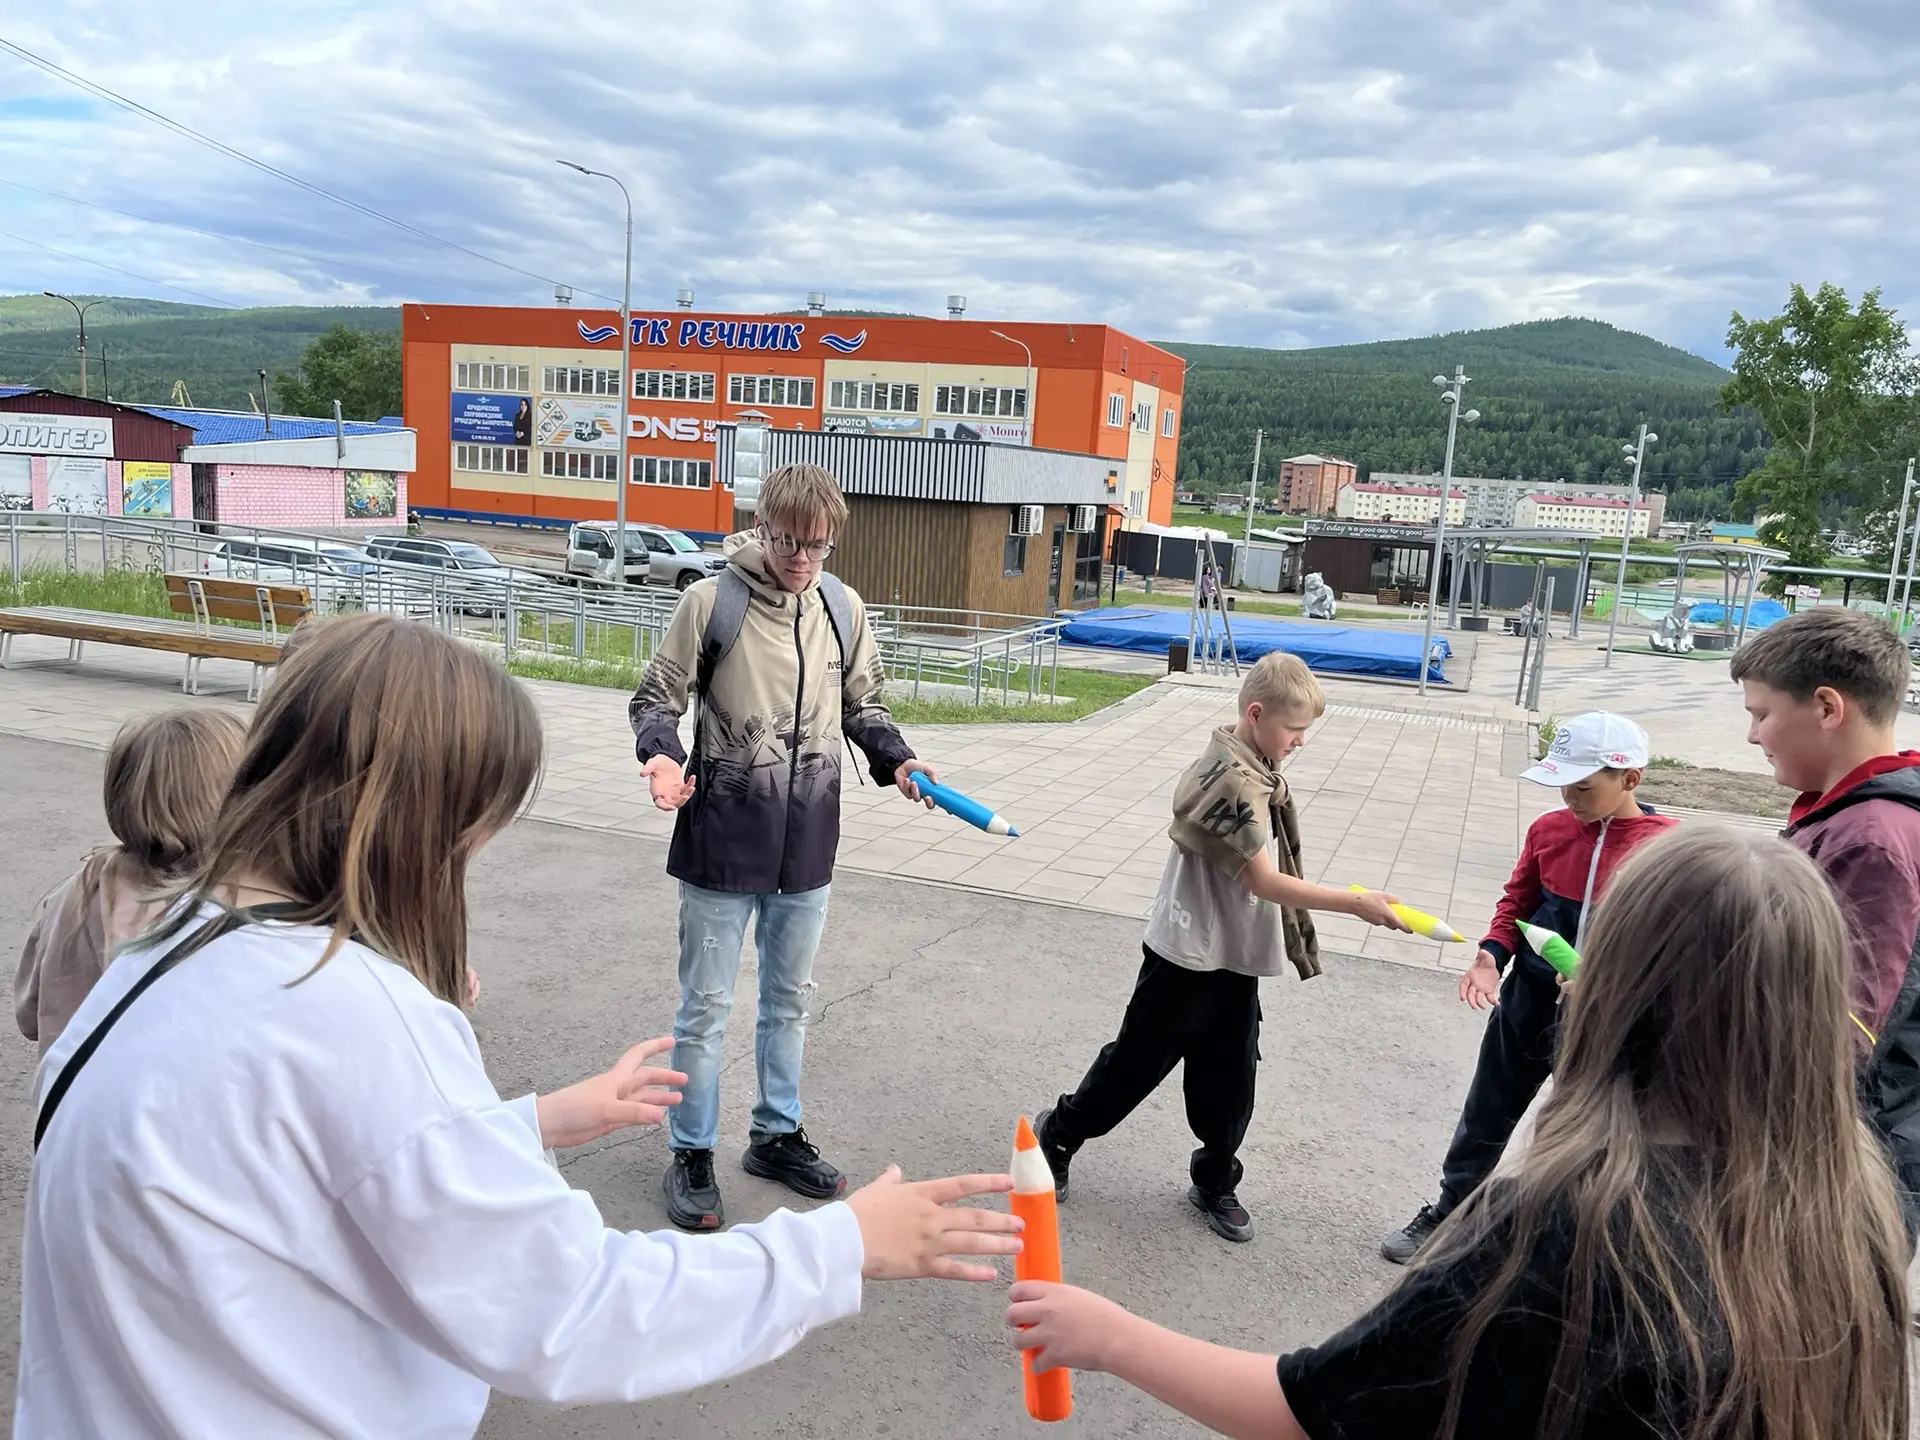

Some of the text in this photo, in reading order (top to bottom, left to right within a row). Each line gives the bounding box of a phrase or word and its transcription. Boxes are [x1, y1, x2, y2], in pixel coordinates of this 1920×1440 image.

[630, 319, 805, 351] ТК РЕЧНИК
[627, 415, 701, 441] DNS
[824, 417, 866, 427] СДАЮТСЯ
[990, 425, 1028, 437] Monro
[1322, 523, 1345, 535] Today
